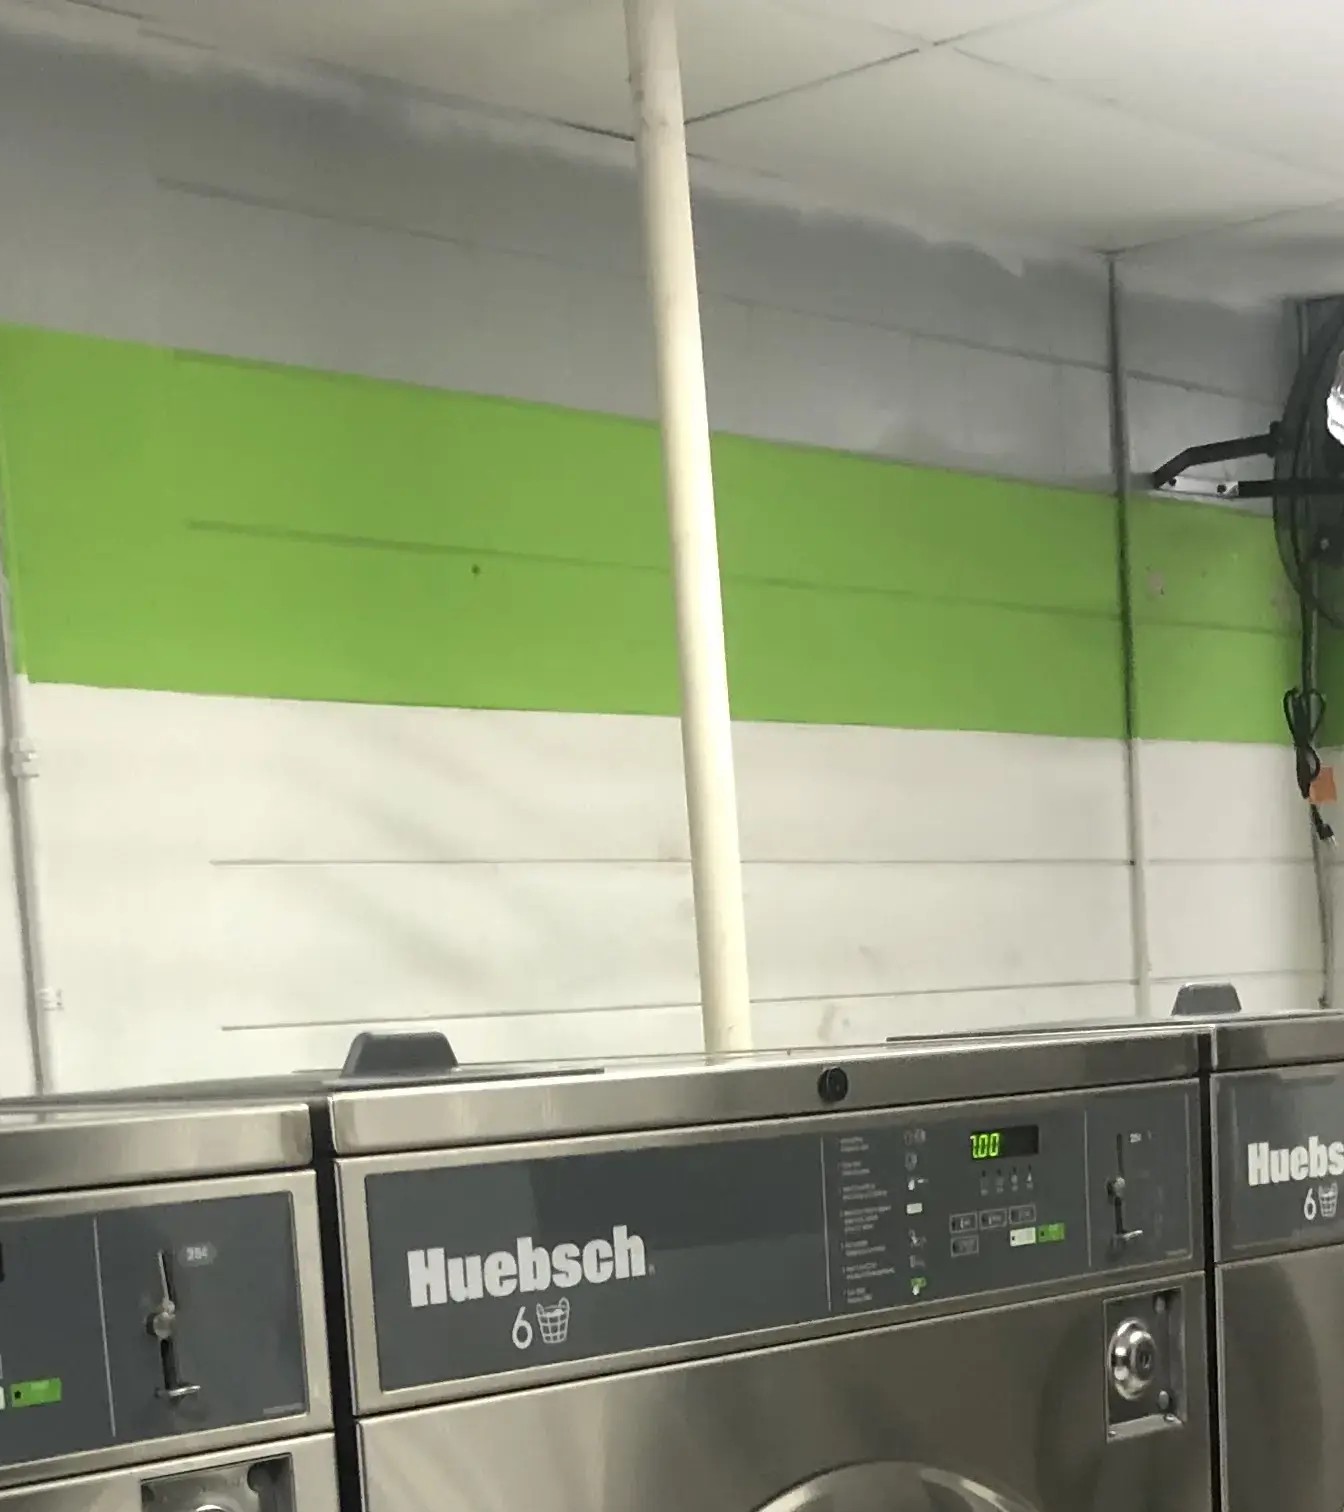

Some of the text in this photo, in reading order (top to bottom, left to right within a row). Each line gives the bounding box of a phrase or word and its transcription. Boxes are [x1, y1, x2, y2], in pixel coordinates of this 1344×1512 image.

[1304, 1187, 1317, 1221] 6
[407, 1224, 646, 1308] Huebsch
[512, 1305, 533, 1349] 6
